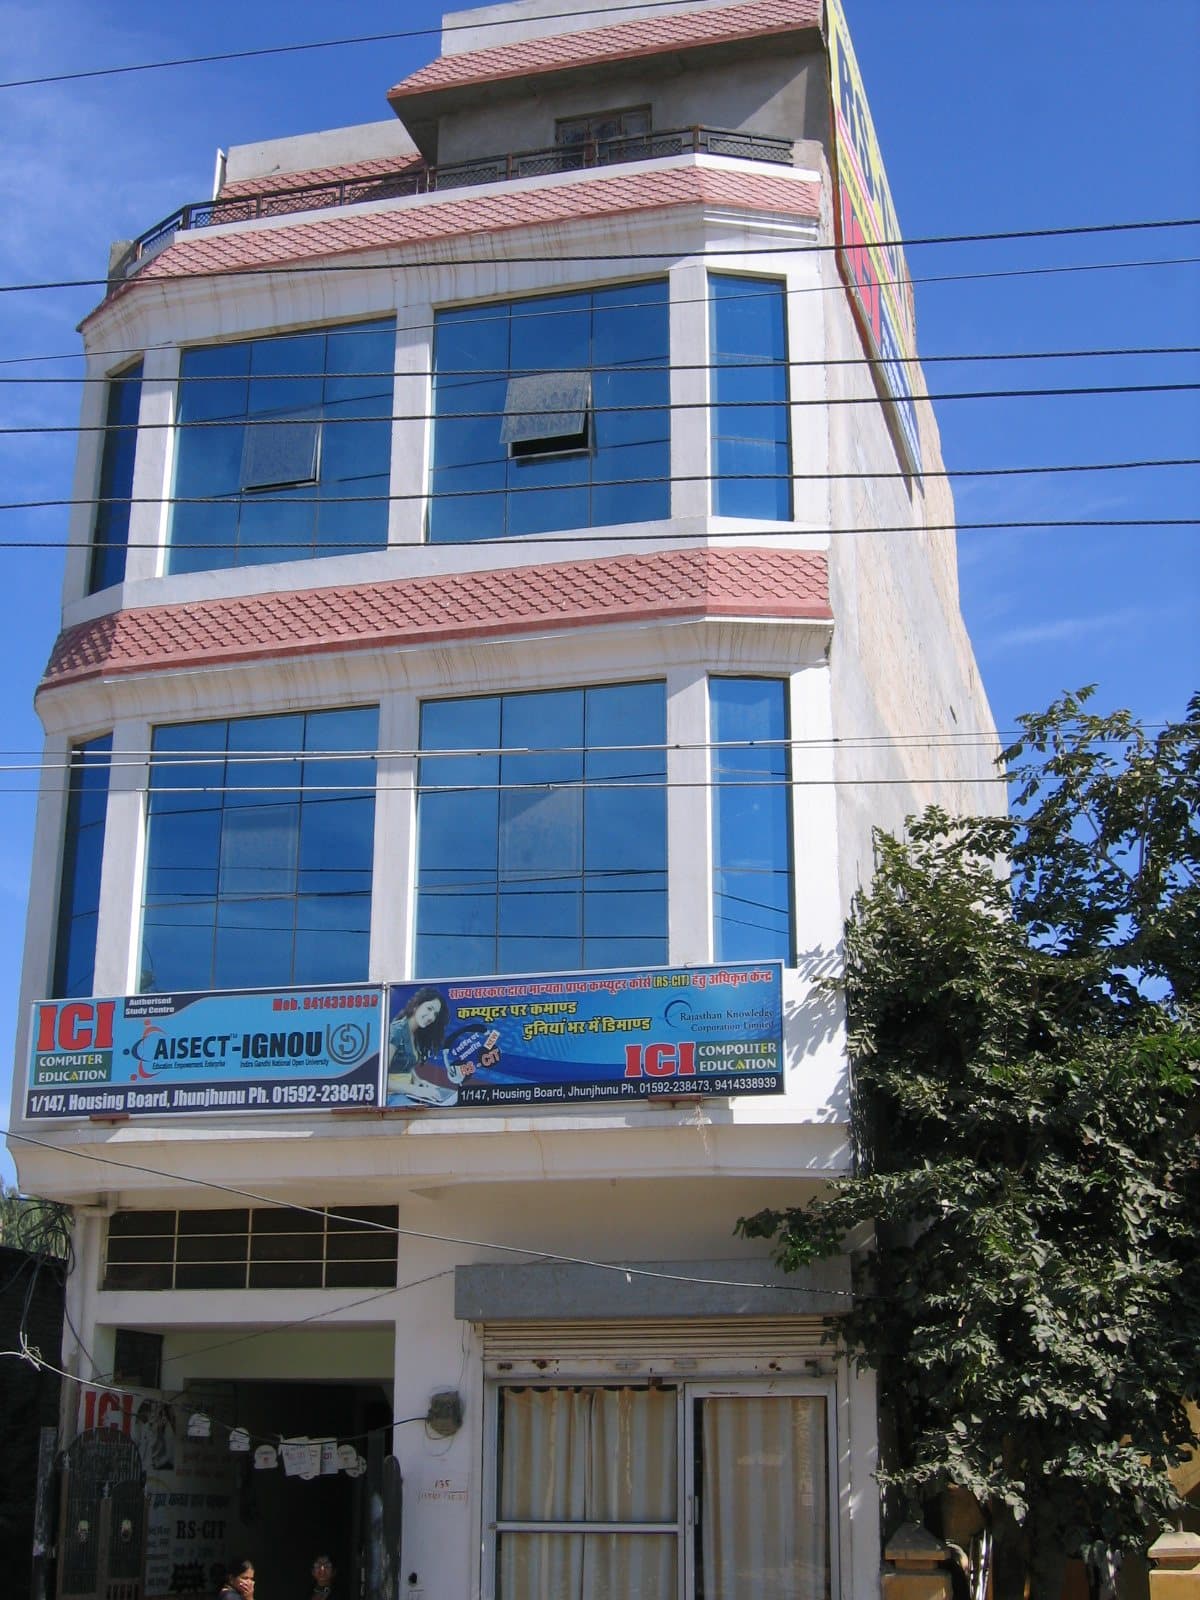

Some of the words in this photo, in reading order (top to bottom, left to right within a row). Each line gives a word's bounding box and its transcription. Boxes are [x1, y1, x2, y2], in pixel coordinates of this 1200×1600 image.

[653, 974, 690, 988] (RS-CIT)
[129, 997, 172, 1007] Authorised
[510, 1004, 528, 1016] पर
[530, 1002, 577, 1014] कमाण्ड
[126, 1006, 147, 1015] Study
[149, 1005, 175, 1014] Centre
[680, 1011, 722, 1022] Rajasthan
[726, 1007, 773, 1018] Knowledge
[36, 1001, 116, 1052] ICI
[567, 1021, 585, 1033] भर
[588, 1016, 602, 1032] में
[691, 1023, 740, 1033] Corporation
[744, 1021, 774, 1031] Limited
[39, 1054, 103, 1067] COMPUTER
[624, 1041, 696, 1078] ICI
[699, 1058, 777, 1072] EDUCATION
[38, 1069, 107, 1083] EDUCATION
[460, 1089, 489, 1102] 1/147,
[492, 1087, 532, 1102] Housing
[534, 1085, 566, 1099] Board,
[568, 1083, 618, 1098] Jhunjhunu
[621, 1083, 636, 1095] Ph.
[639, 1080, 713, 1094] 01592-238473,
[715, 1077, 776, 1090] 9414338939
[31, 1094, 67, 1113] 1/147,
[69, 1092, 125, 1111] Housing
[127, 1089, 170, 1109] Board,
[173, 1086, 245, 1108] Jhunjhunu
[249, 1086, 269, 1104] Ph.
[272, 1084, 375, 1103] 01592-238473
[85, 1391, 134, 1436] ICI
[175, 1520, 226, 1540] RS-CIT
